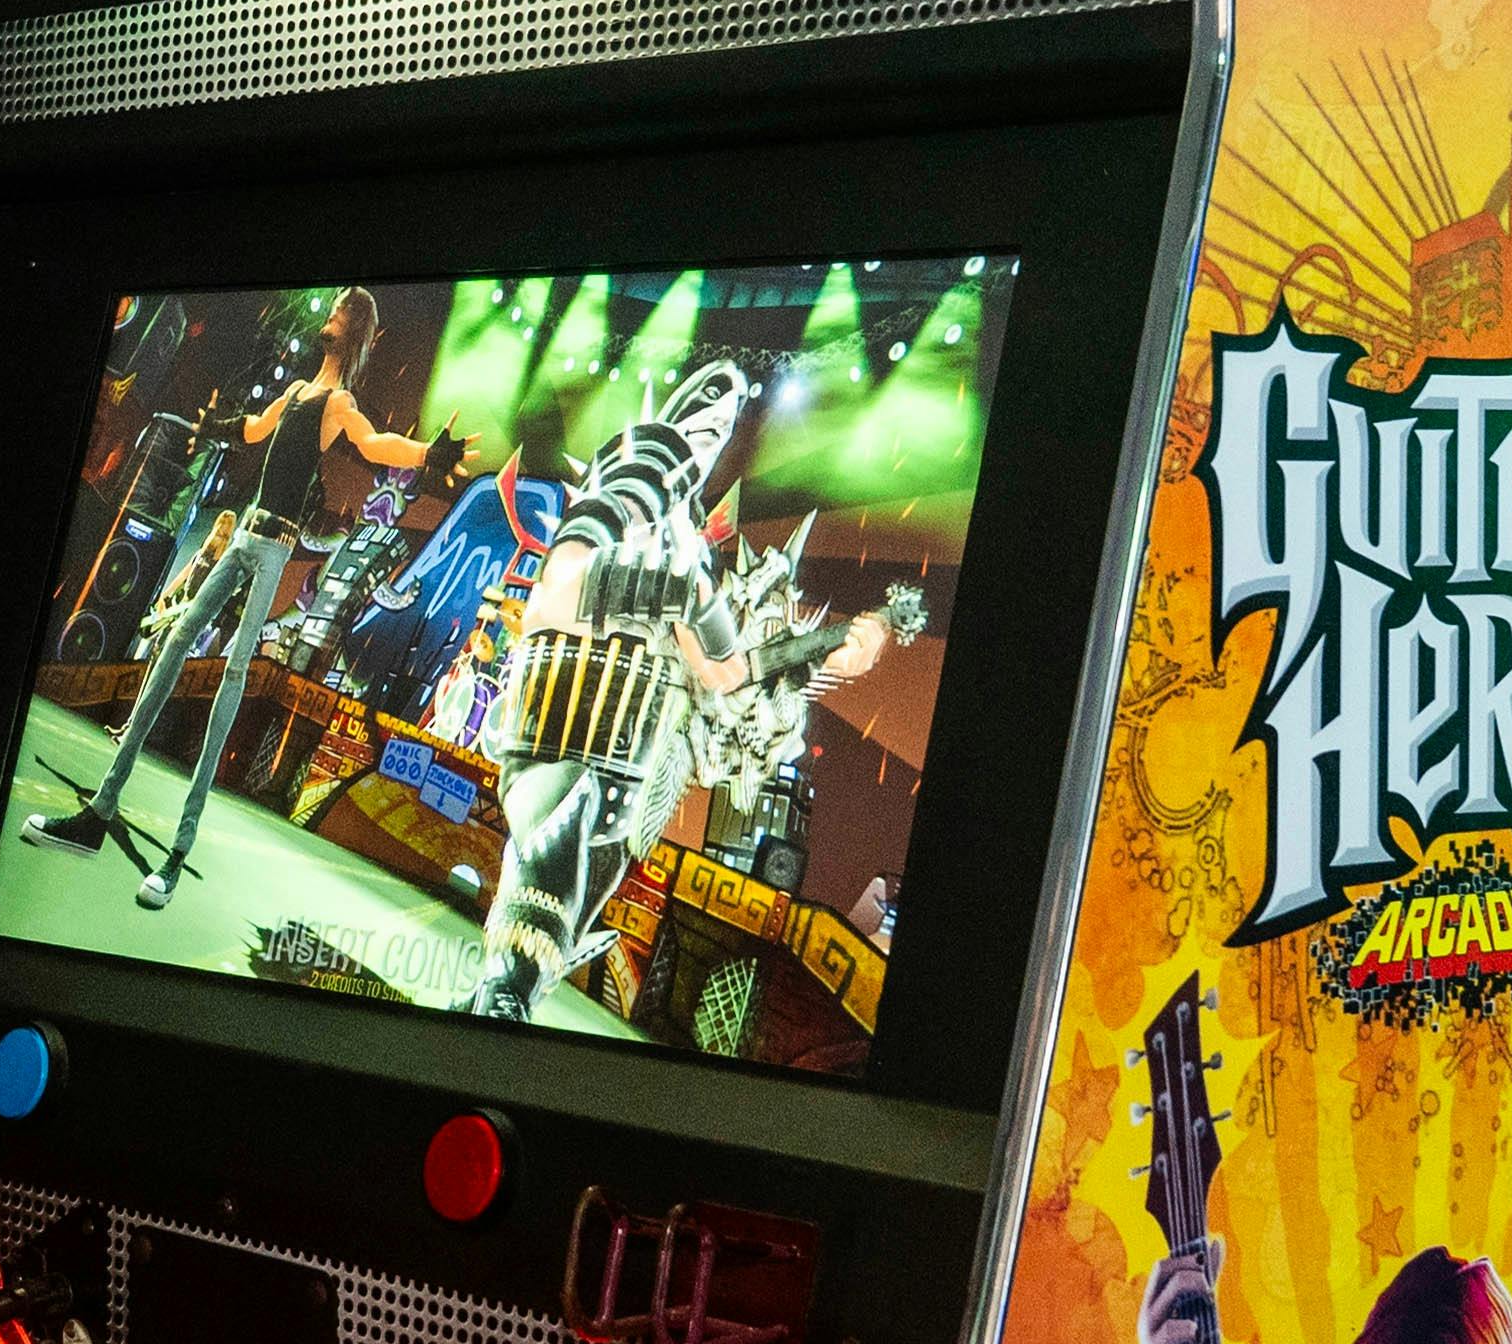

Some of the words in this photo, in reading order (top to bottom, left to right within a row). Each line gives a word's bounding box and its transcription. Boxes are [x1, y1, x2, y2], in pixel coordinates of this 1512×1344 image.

[262, 915, 377, 975] INSERT
[381, 932, 484, 993] COINS
[320, 972, 363, 996] CREDITS
[366, 980, 381, 999] TO
